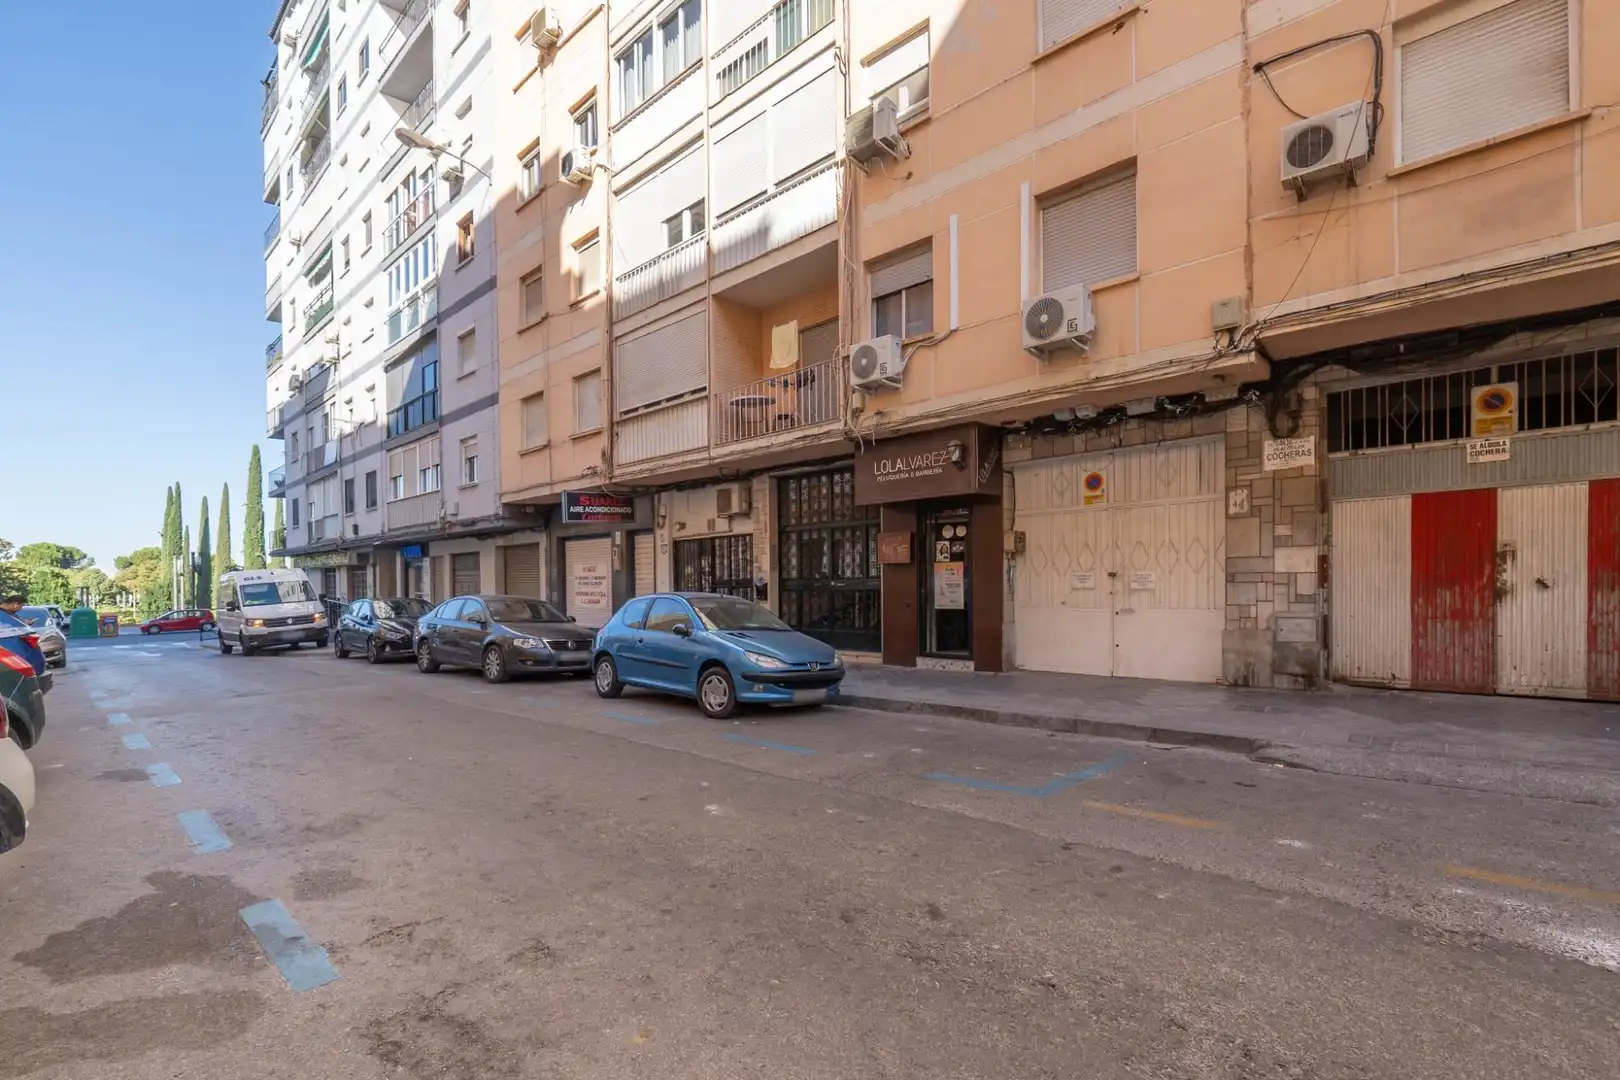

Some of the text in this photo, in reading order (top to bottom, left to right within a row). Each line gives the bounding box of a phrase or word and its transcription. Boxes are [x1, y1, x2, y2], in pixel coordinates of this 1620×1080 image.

[1479, 440, 1507, 449] ALQUILA
[1266, 448, 1312, 461] COCHERAS
[1470, 447, 1507, 457] COCHERA
[585, 506, 632, 514] ACONDICIONADO
